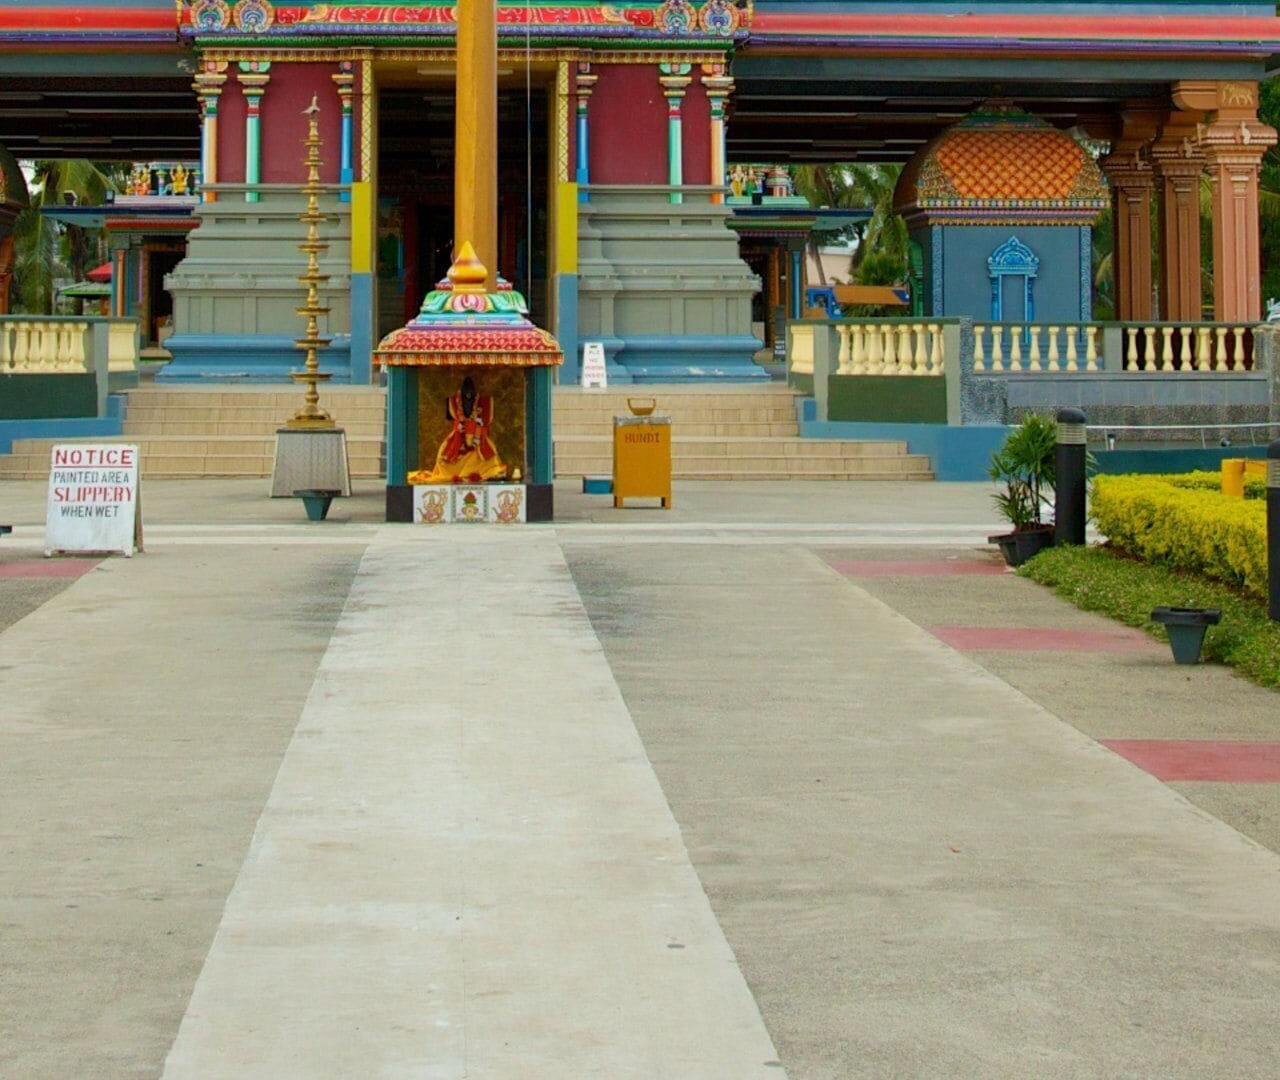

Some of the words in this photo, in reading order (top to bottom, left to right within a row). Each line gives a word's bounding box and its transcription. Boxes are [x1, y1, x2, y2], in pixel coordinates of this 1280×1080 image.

[55, 449, 134, 465] NOTICE
[53, 471, 99, 484] PAINTED
[101, 471, 130, 484] AREA
[53, 486, 134, 502] SLIPPERY
[60, 505, 93, 518] WHEN
[95, 505, 120, 518] WET
